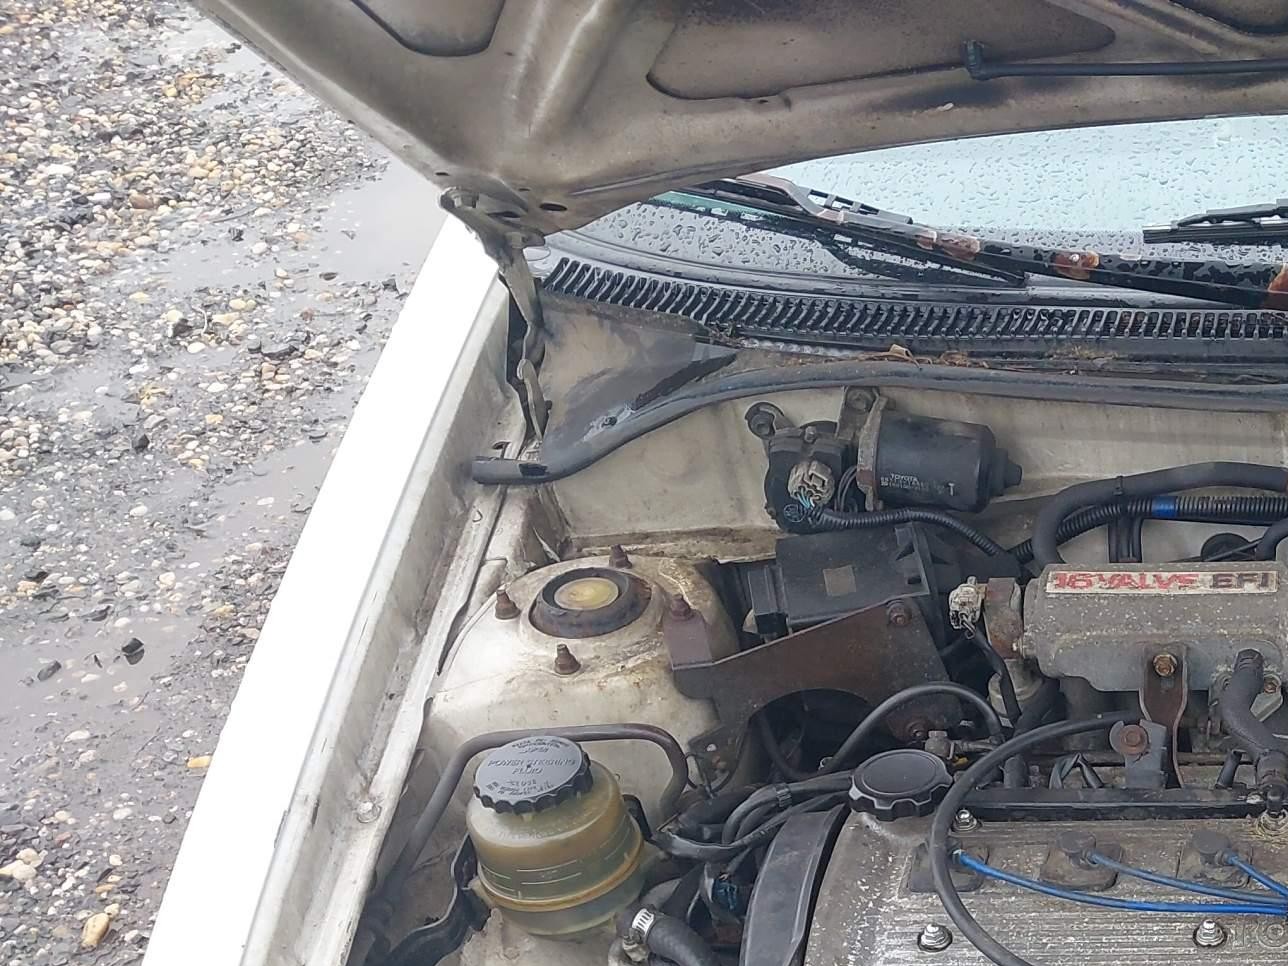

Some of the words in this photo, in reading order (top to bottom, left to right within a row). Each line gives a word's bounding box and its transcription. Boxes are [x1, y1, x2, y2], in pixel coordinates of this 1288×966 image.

[889, 473, 918, 483] TOYOTA
[1054, 572, 1093, 589] 16
[1096, 572, 1200, 590] VALVE
[1210, 571, 1270, 590] EFI
